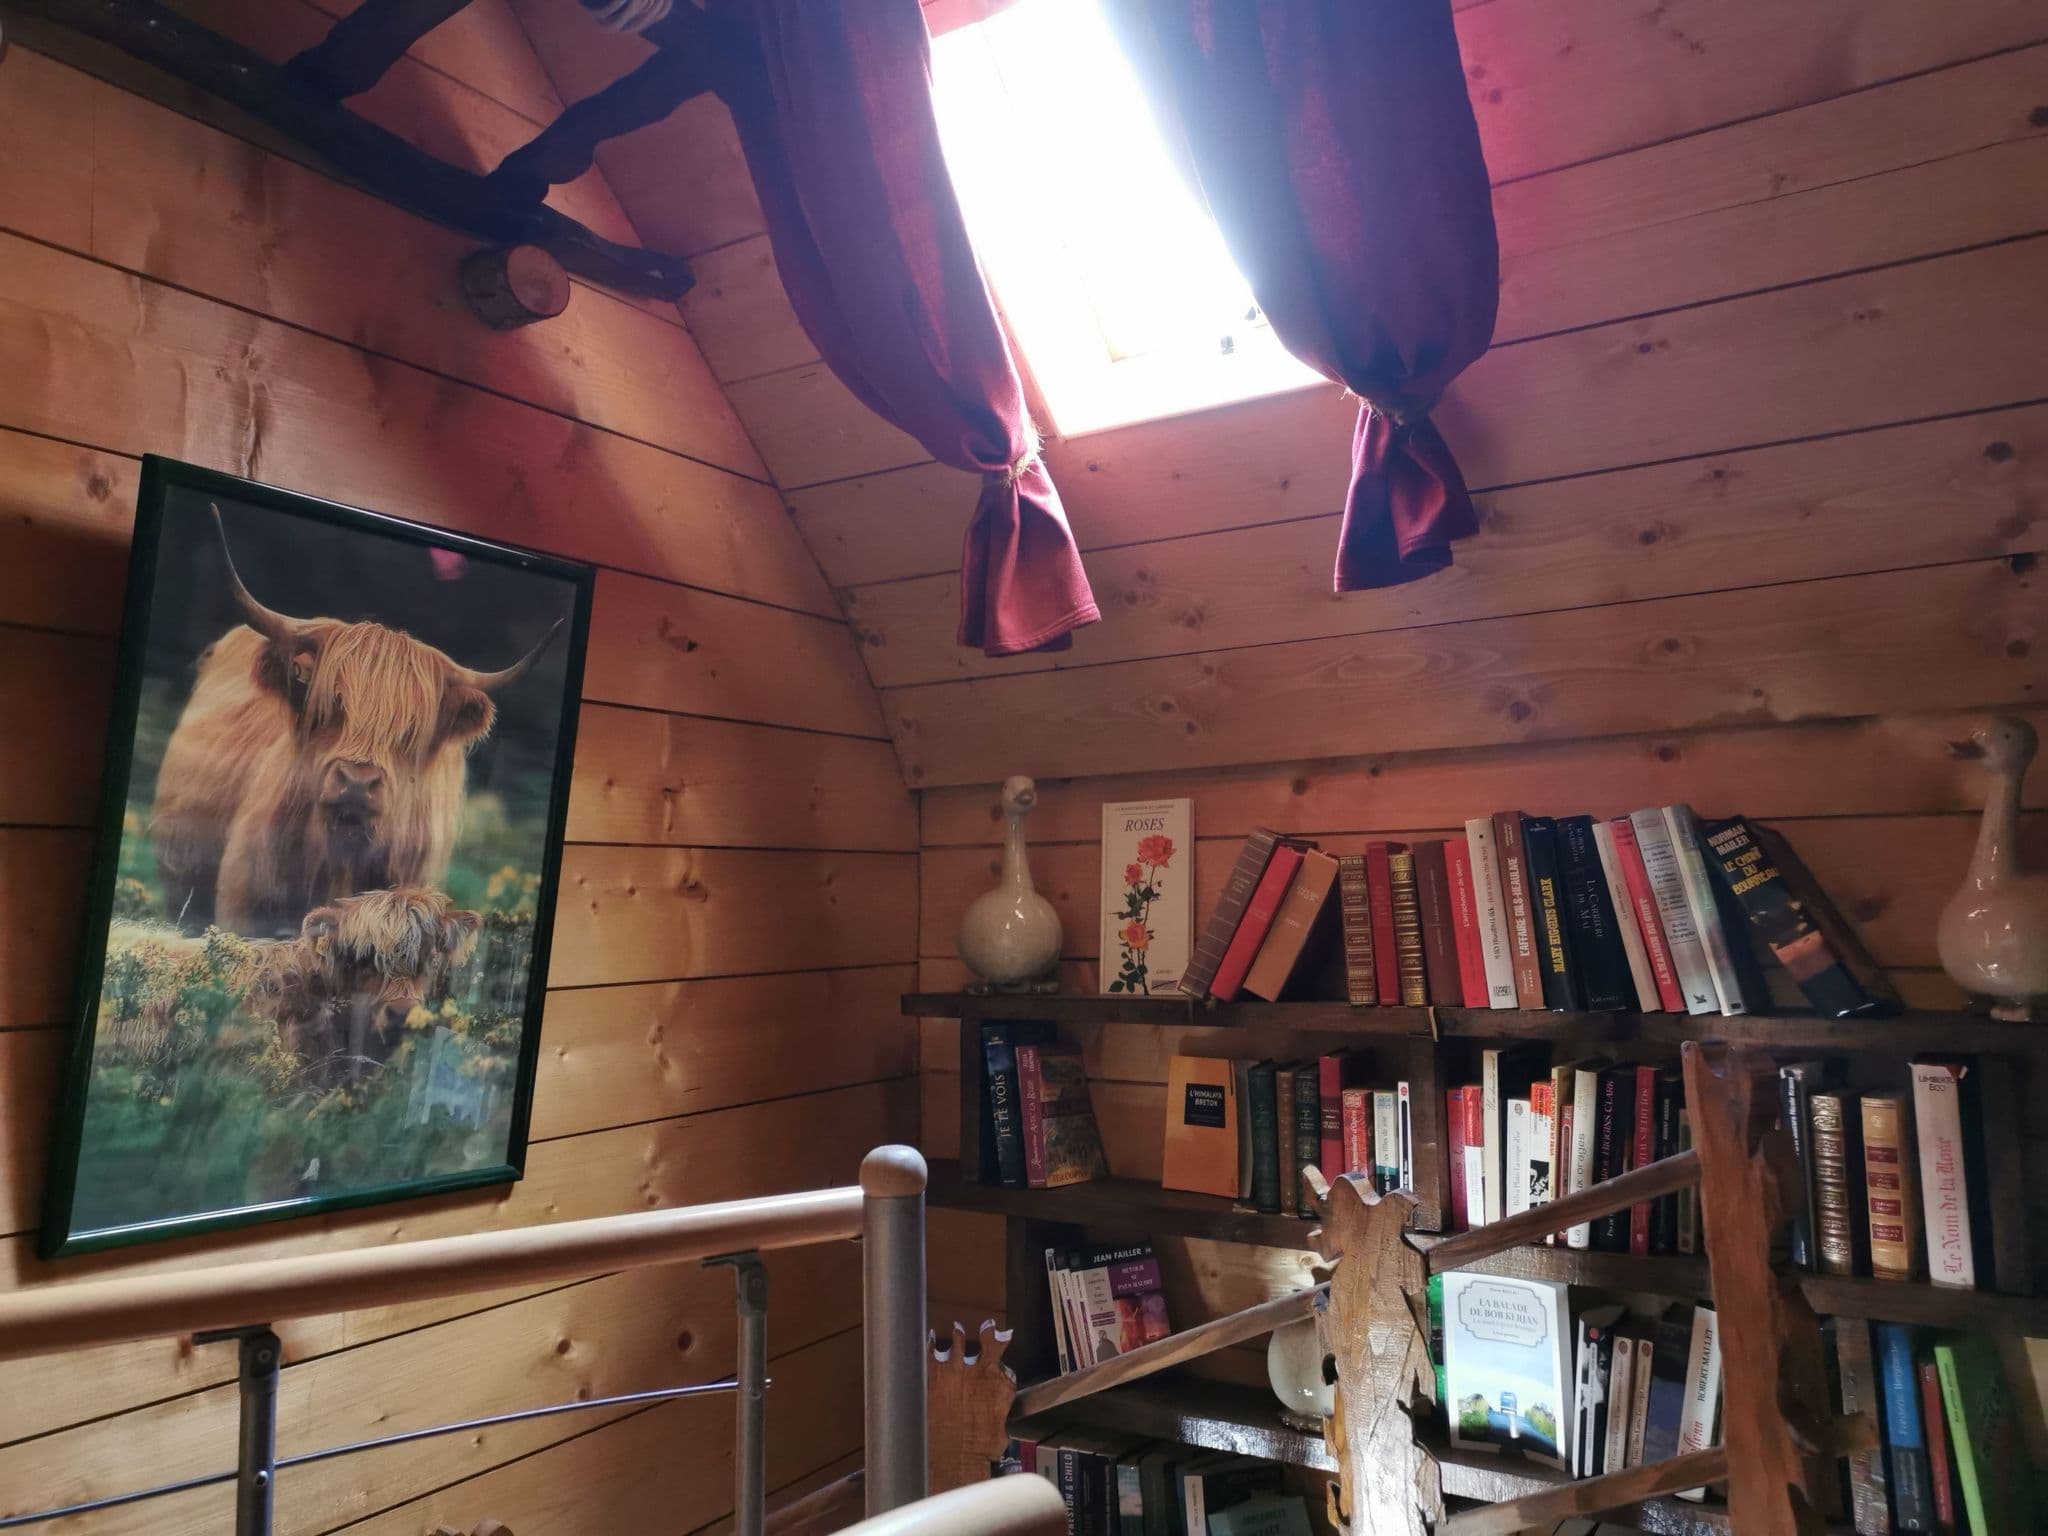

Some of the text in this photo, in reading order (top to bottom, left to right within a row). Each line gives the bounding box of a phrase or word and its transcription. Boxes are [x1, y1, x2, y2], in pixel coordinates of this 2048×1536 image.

[1125, 817, 1165, 832] ROSES
[1706, 823, 1747, 847] NORMAN
[1715, 834, 1751, 856] MAILER
[1455, 858, 1463, 876] dents
[1723, 860, 1737, 873] LE
[1742, 864, 1758, 877] DU
[1540, 878, 1566, 973] MARY HIGGINS CLARK
[1646, 922, 1658, 936] DU
[1515, 917, 1530, 957] L'AFFAIRE
[1649, 937, 1667, 971] MAISON
[1660, 972, 1672, 985] LA
[1189, 1089, 1223, 1099] L'HIMALAYA
[1604, 1080, 1614, 1112] CLARK
[1928, 1083, 1946, 1092] ECO
[994, 1074, 1012, 1138] JE TE VOIS
[1195, 1098, 1218, 1107] BRETON
[1602, 1113, 1613, 1155] HIGGINS
[1575, 1132, 1586, 1175] orages
[1938, 1177, 1954, 1192] la
[1940, 1193, 1957, 1211] de
[1942, 1215, 1961, 1250] Nom
[1092, 1247, 1142, 1264] JEAN FAILLER
[1943, 1254, 1962, 1274] Le
[1469, 1307, 1484, 1316] DE
[1479, 1298, 1529, 1313] LA BALADE
[1702, 1328, 1714, 1366] MALLET
[1698, 1367, 1709, 1402] ROBERT
[1064, 1454, 1073, 1482] CHILD
